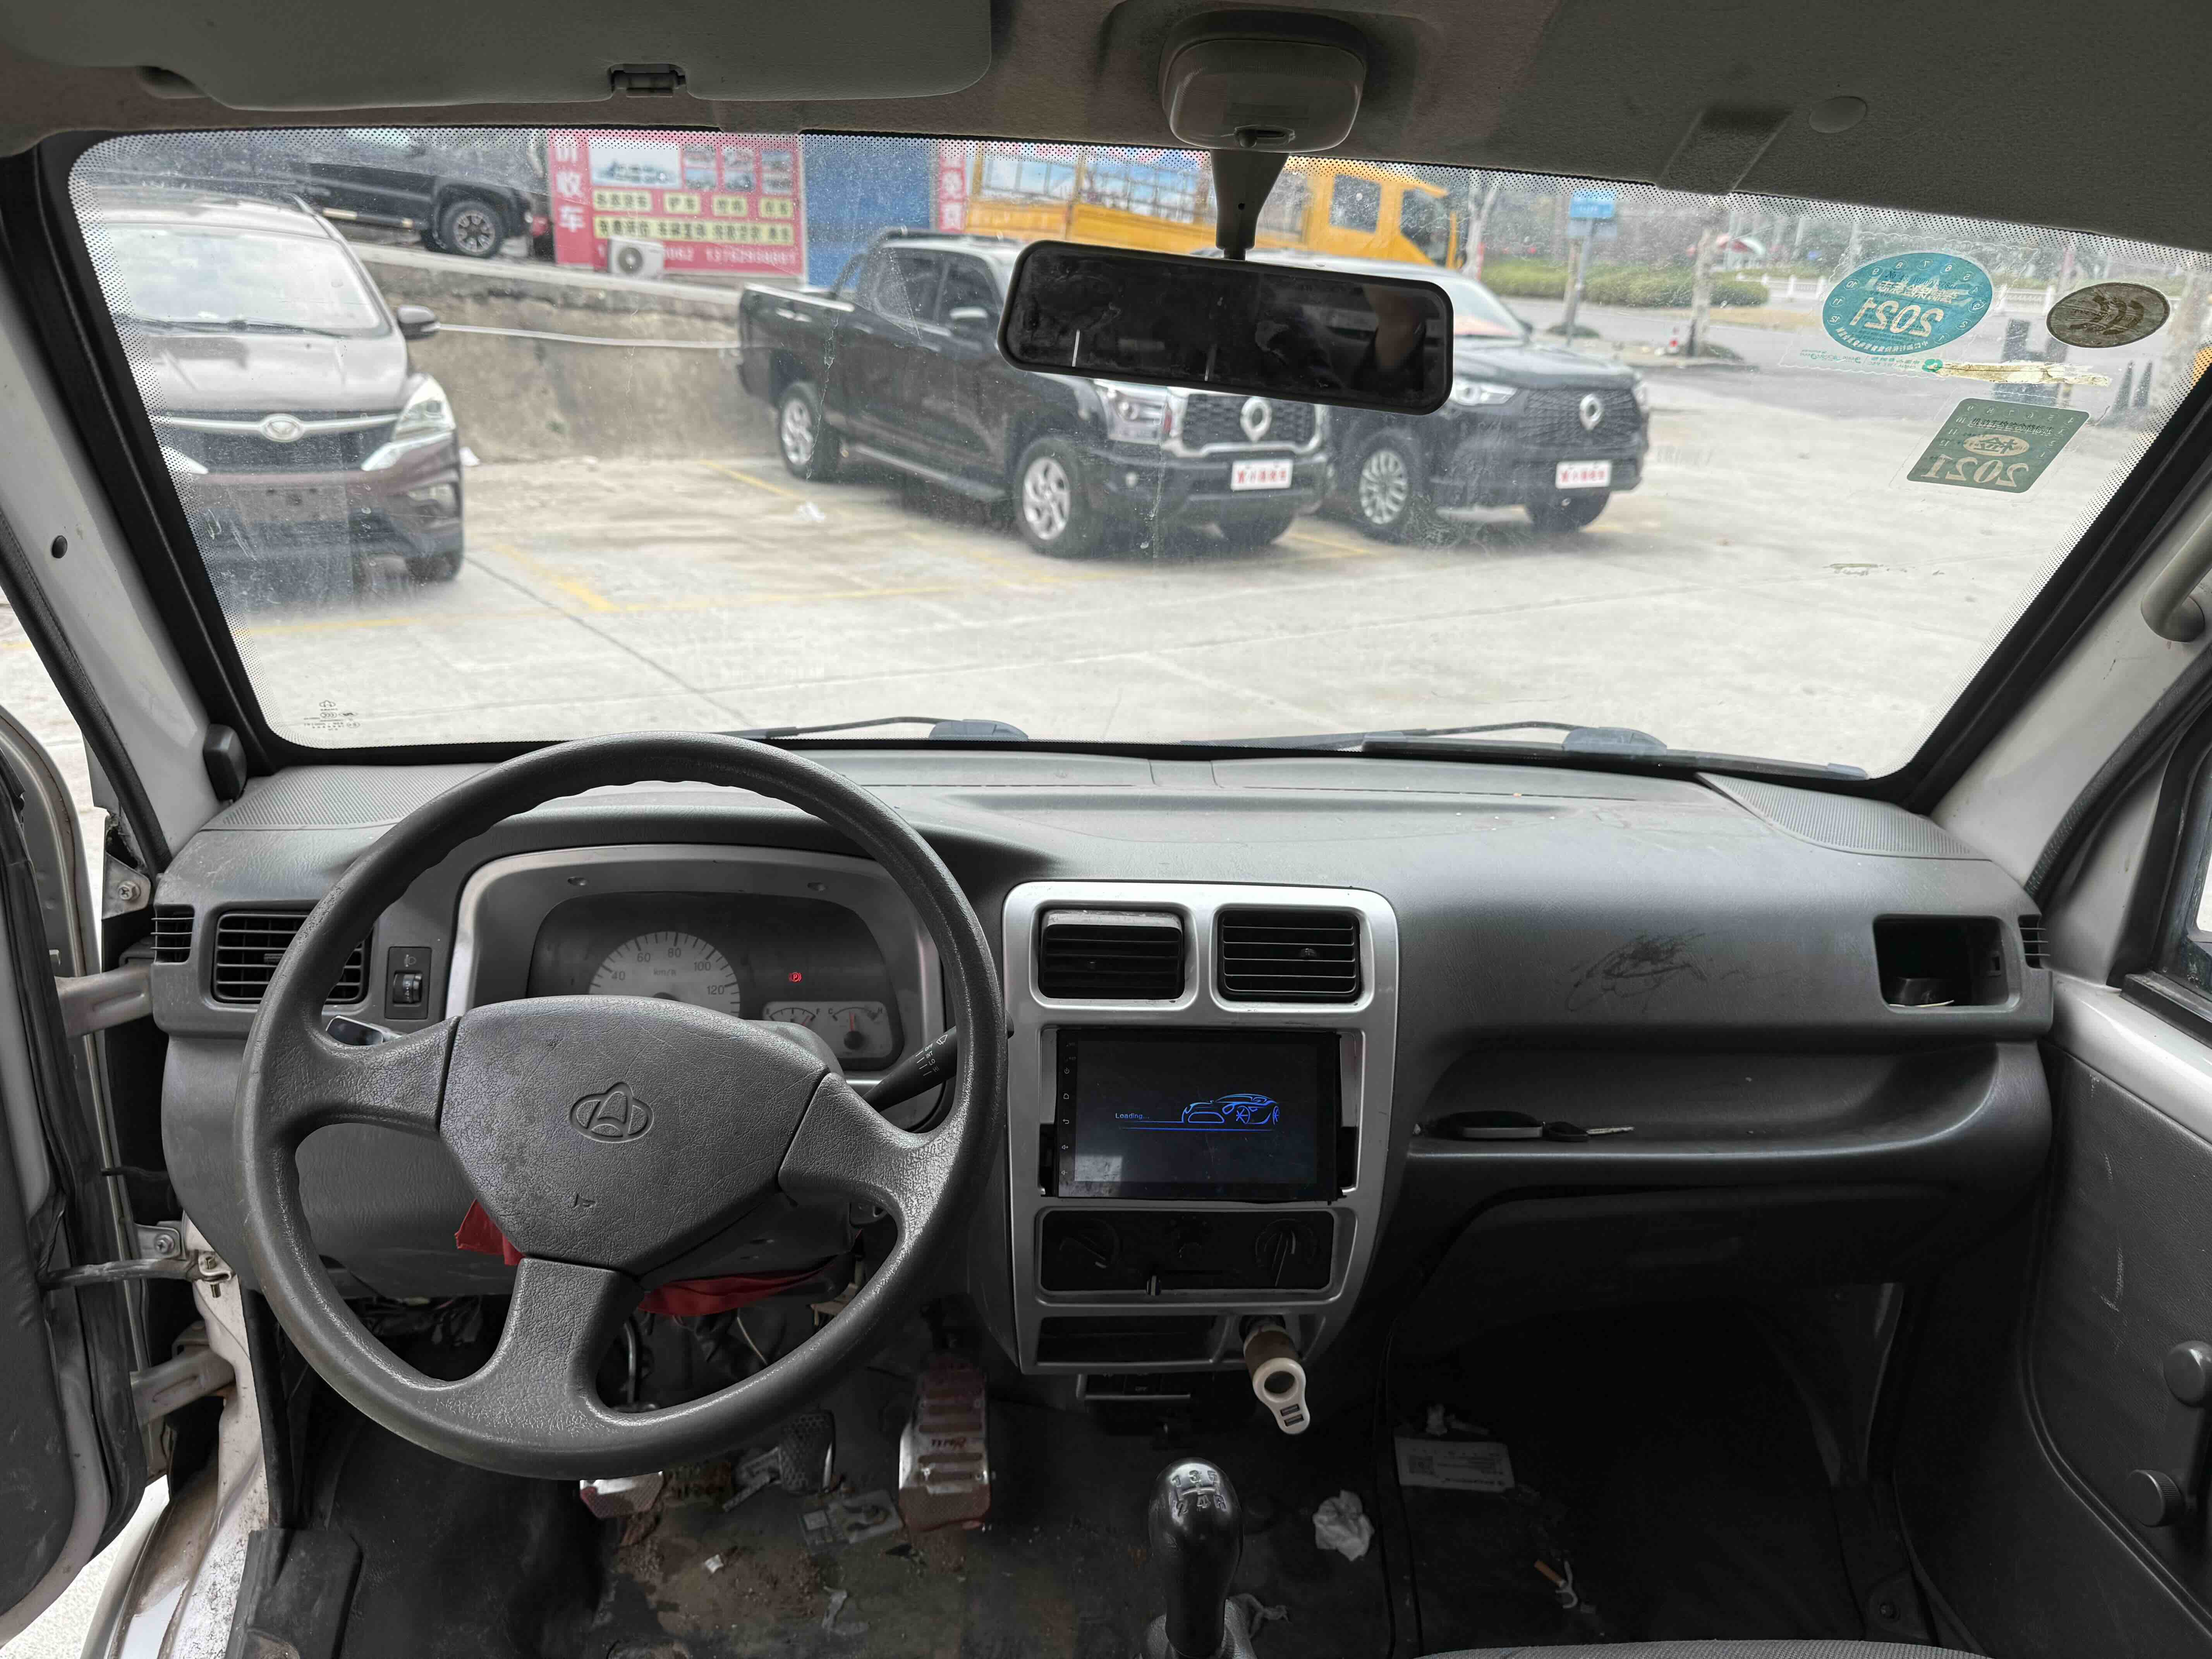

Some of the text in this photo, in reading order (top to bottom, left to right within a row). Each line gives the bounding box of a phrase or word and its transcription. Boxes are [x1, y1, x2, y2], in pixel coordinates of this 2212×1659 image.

[637, 953, 651, 962] 60
[668, 948, 681, 957] 80
[694, 961, 711, 971] 100
[611, 971, 625, 981] 40
[707, 985, 725, 995] 120
[925, 1043, 933, 1051] OFF
[1189, 1470, 1202, 1483] 3
[1207, 1470, 1220, 1483] 5
[1197, 1495, 1211, 1509] 4
